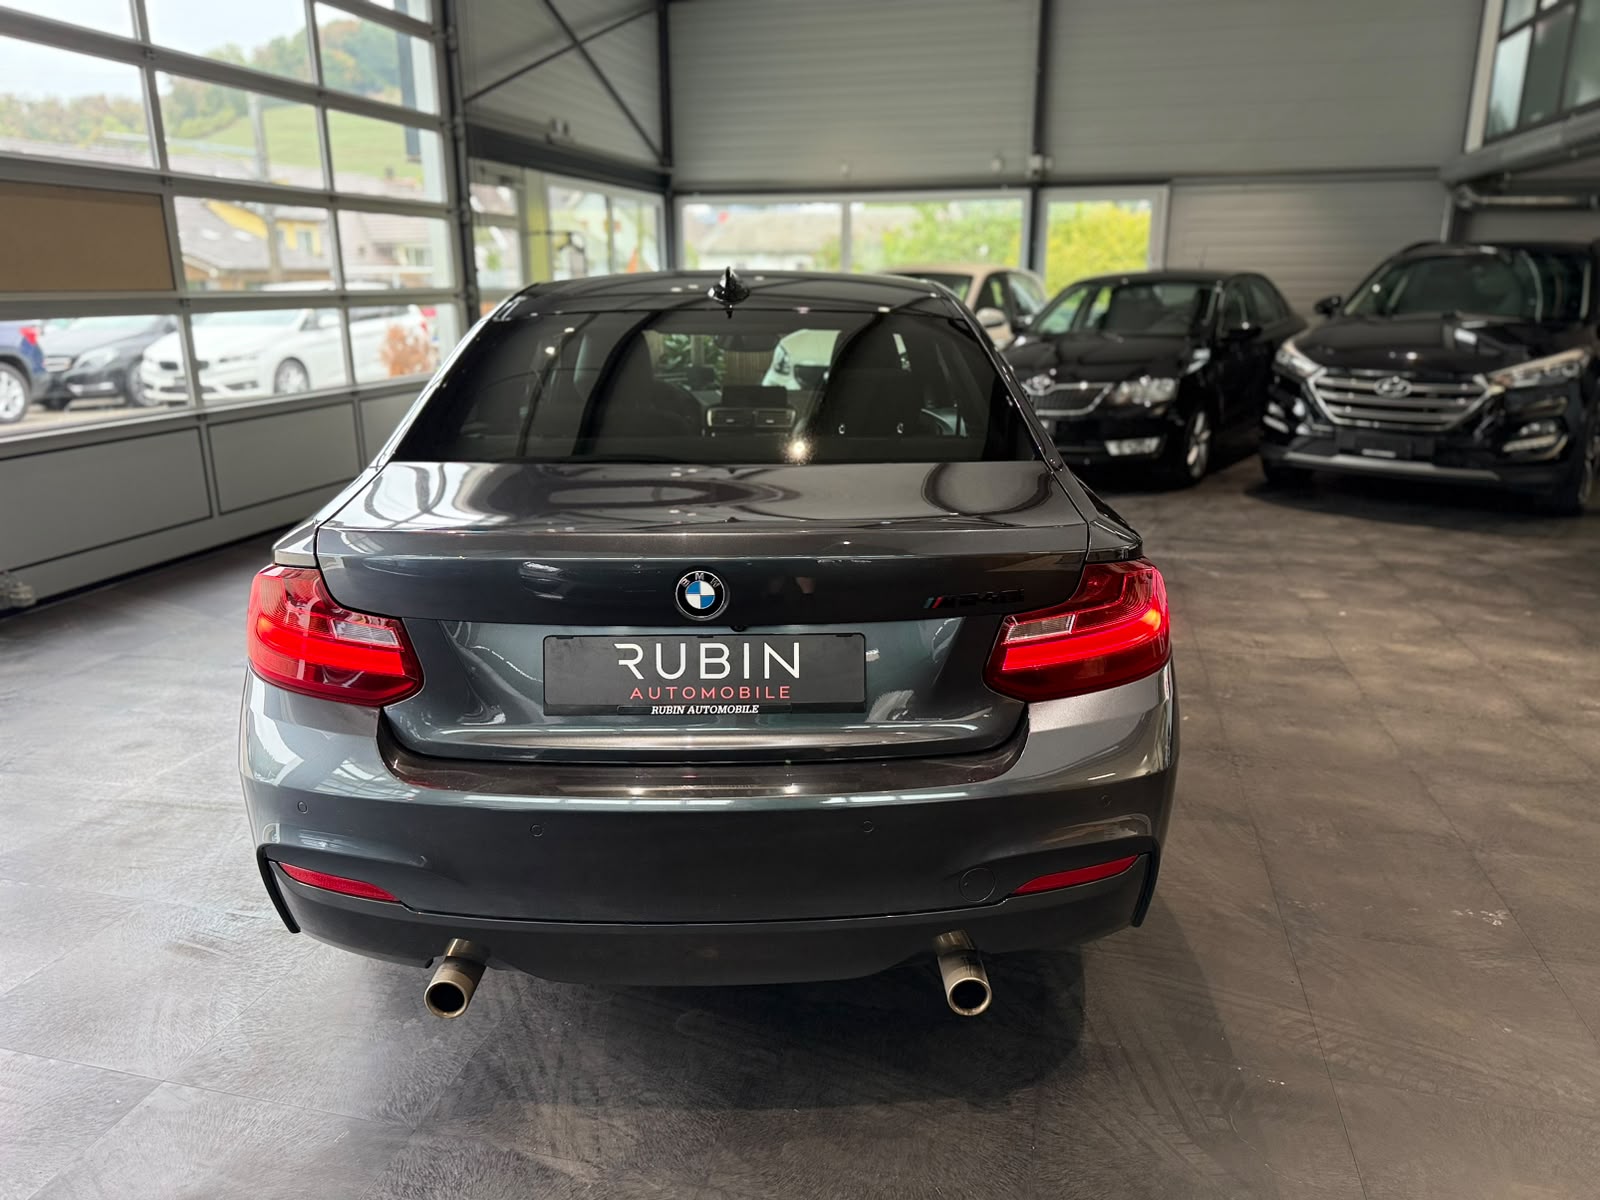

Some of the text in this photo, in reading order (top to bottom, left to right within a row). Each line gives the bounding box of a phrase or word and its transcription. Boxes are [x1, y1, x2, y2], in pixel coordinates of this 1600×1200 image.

[681, 572, 720, 588] BMW
[614, 642, 800, 680] RUBIN
[630, 686, 791, 700] AUTOMOBILE
[651, 704, 760, 715] RUBIN AUTOMOBILE
